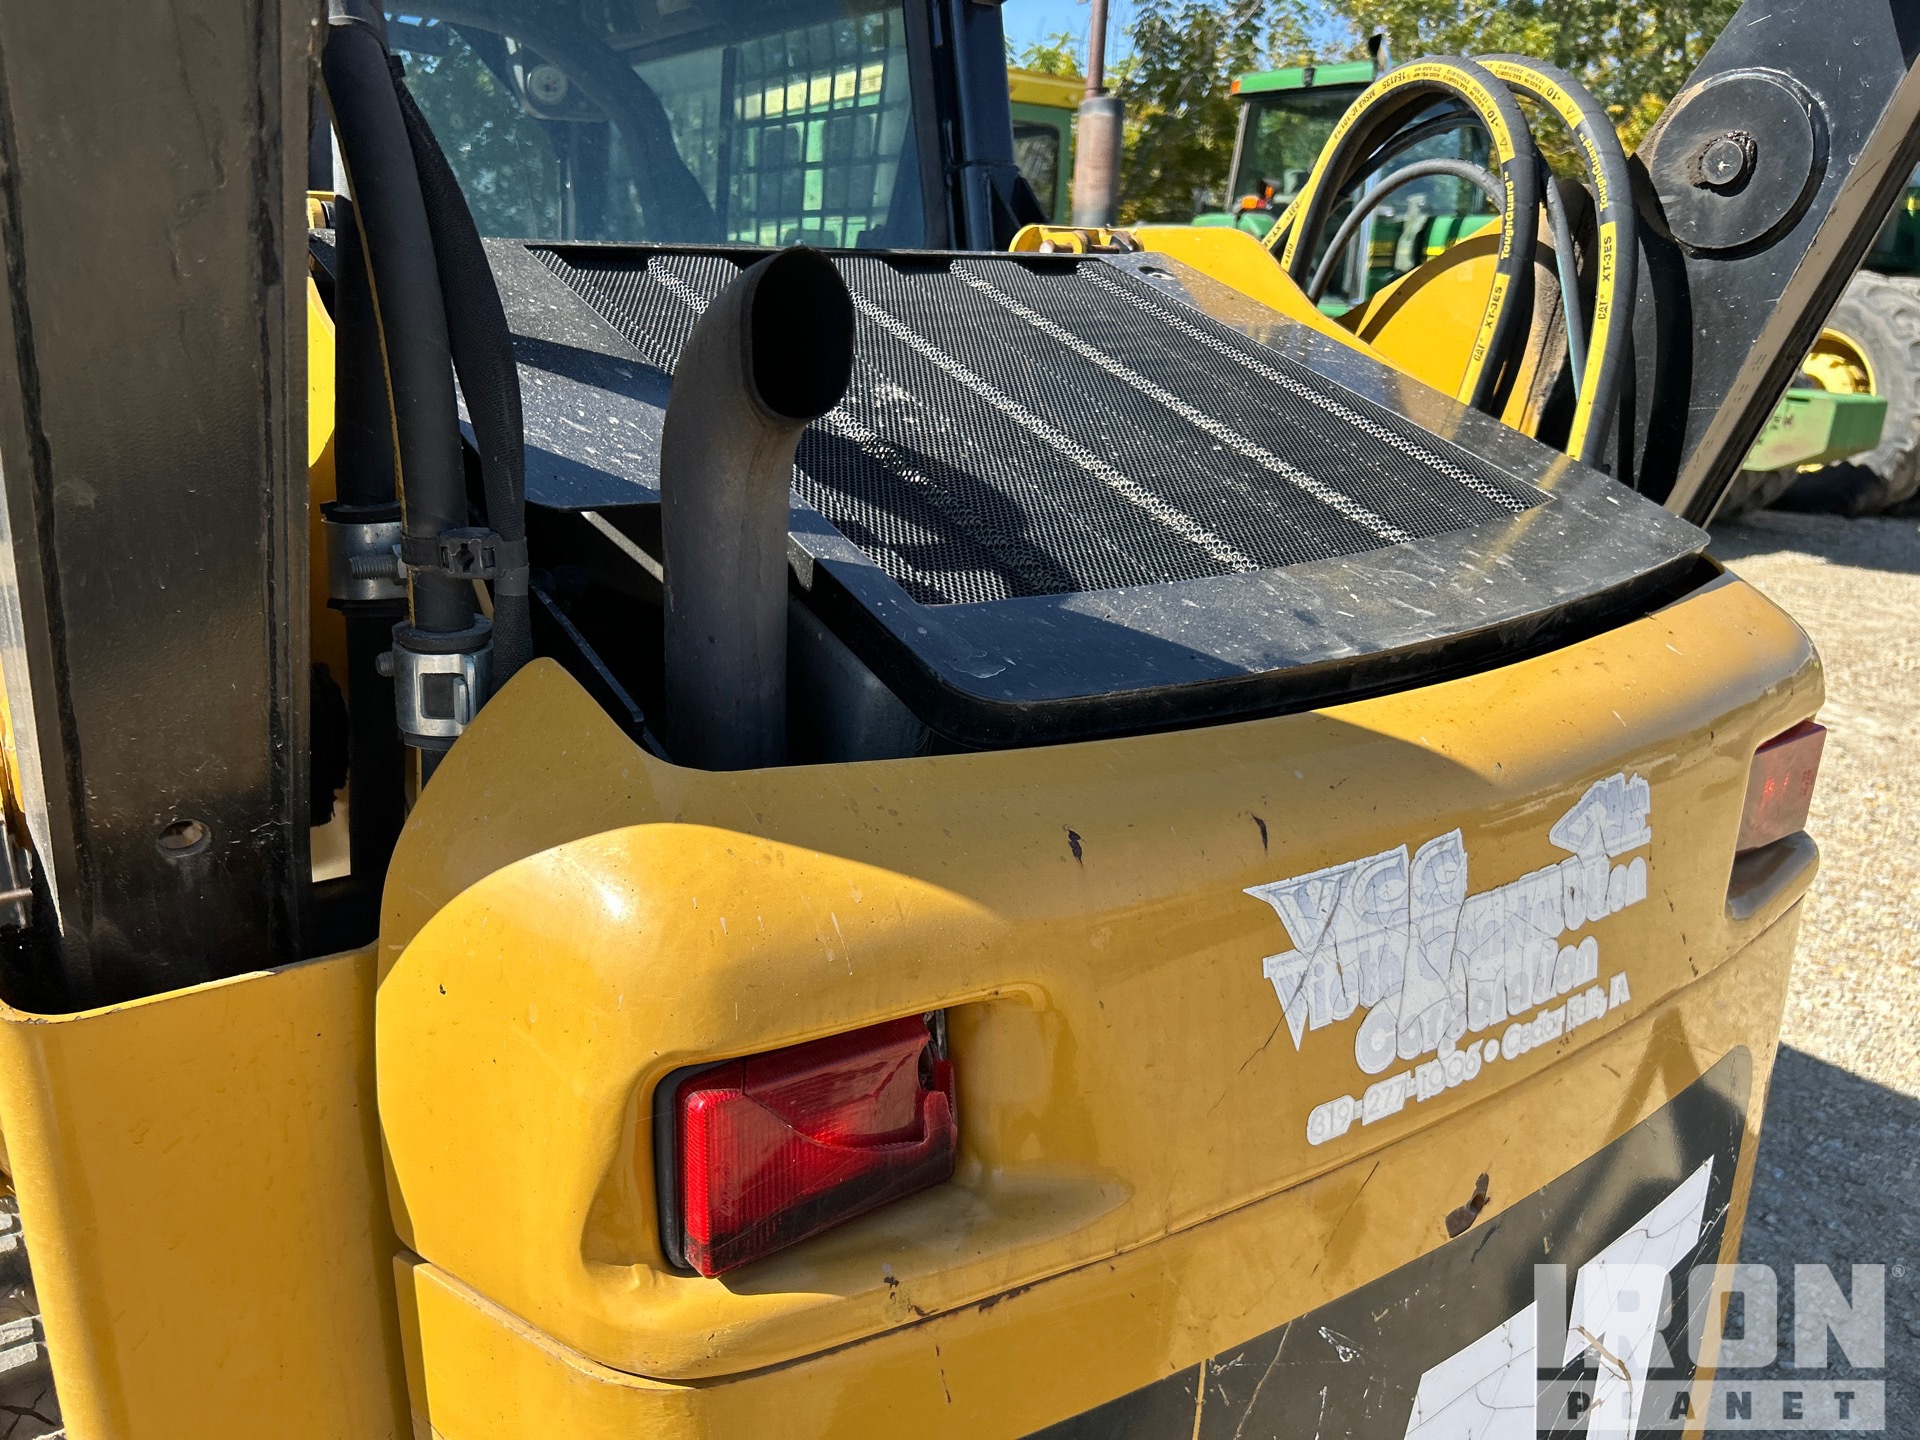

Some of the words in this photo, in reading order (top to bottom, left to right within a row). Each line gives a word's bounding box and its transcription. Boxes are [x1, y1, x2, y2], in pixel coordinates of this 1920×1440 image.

[1602, 235, 1613, 282] XT-3ES
[1485, 285, 1503, 329] XT-3ES
[1501, 1005, 1566, 1060] Cedar
